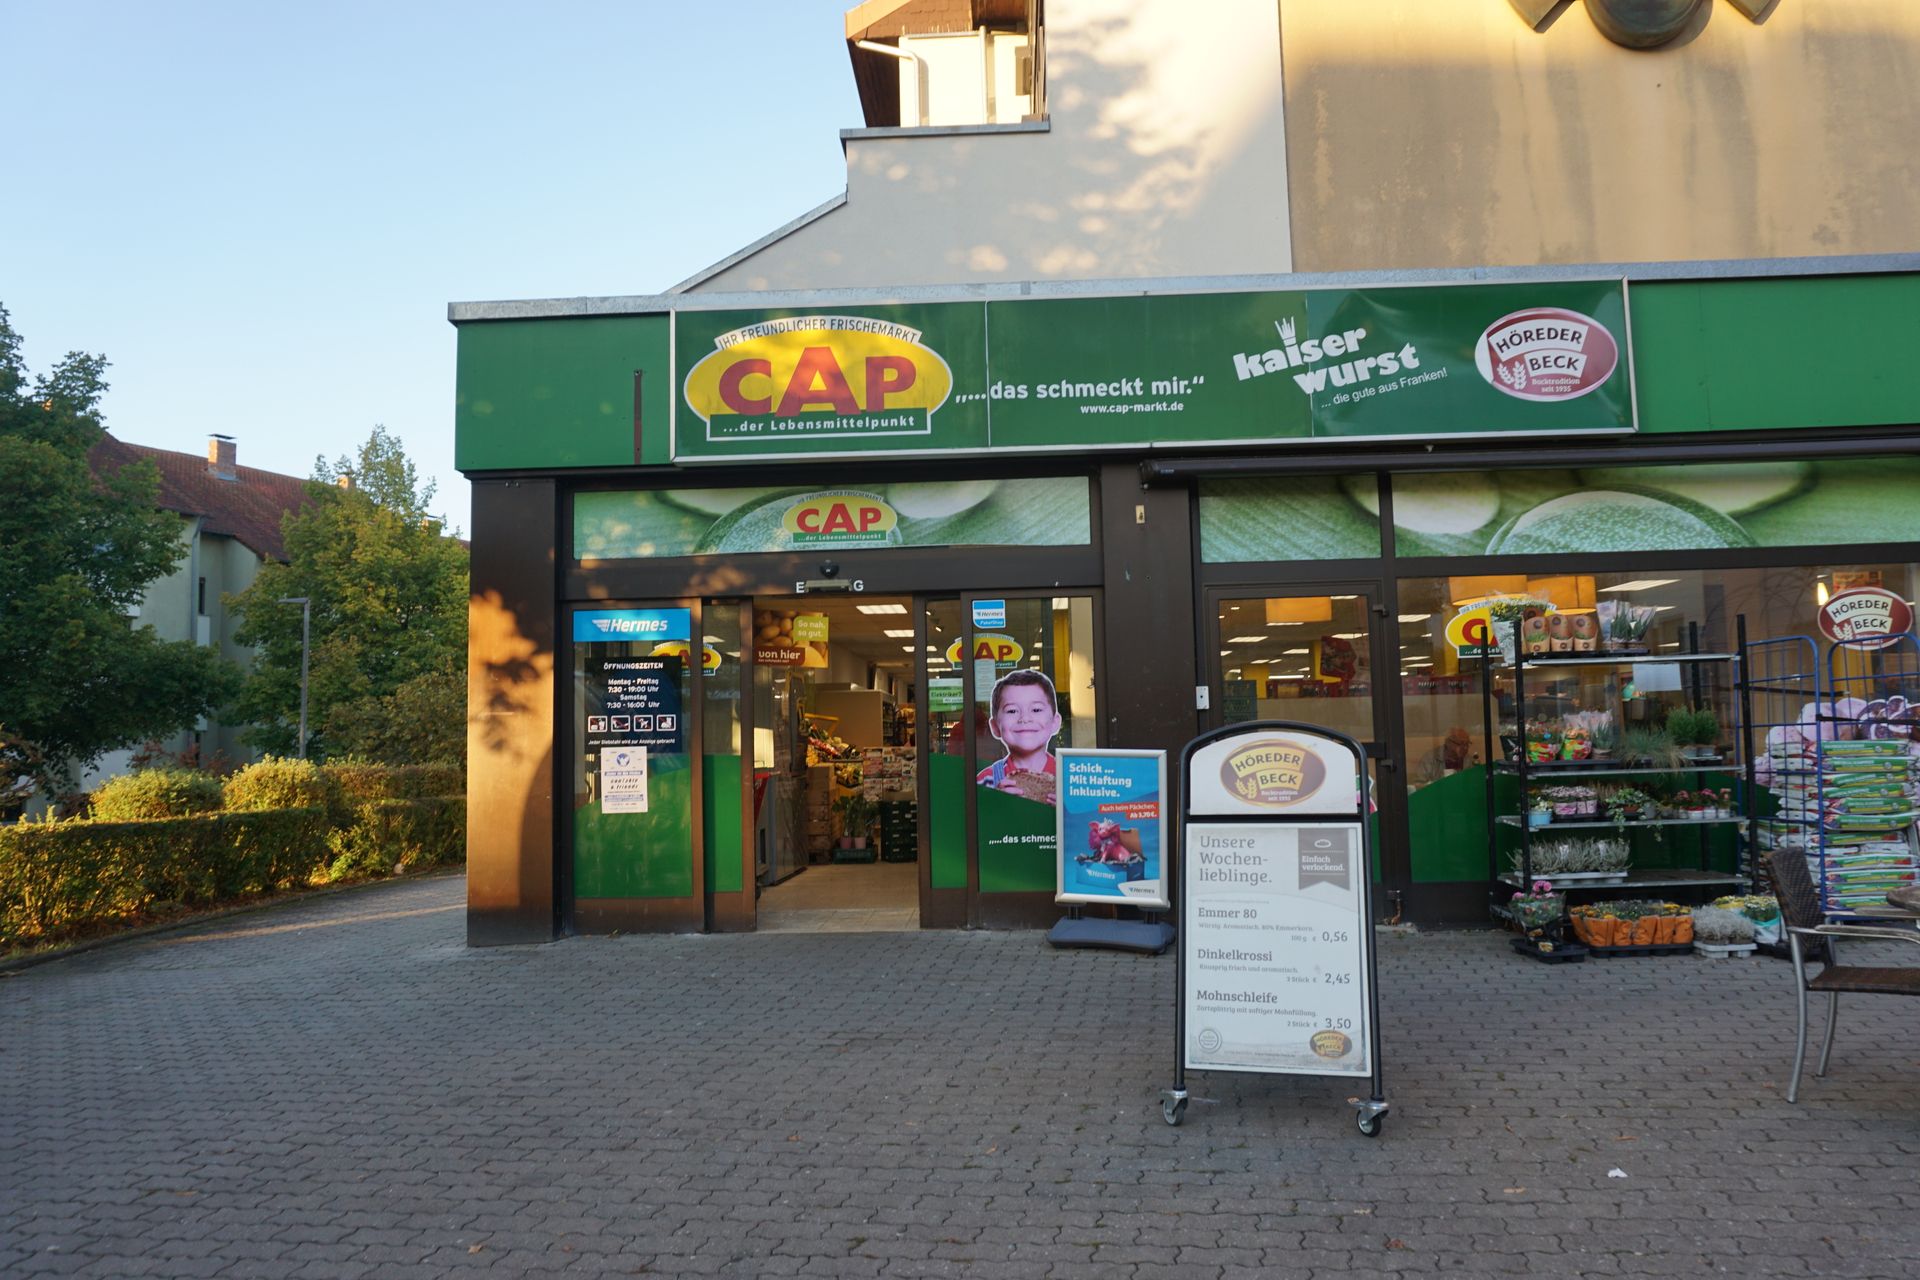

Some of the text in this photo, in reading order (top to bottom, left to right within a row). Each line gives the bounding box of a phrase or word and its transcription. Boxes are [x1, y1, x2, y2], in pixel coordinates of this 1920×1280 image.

[718, 318, 918, 351] IHR FREUNDLICHER FRISCHEMARKT
[1495, 327, 1583, 354] HÖREDER
[1232, 325, 1367, 382] kaiser
[1292, 342, 1421, 395] wurst
[1528, 355, 1581, 372] BECK
[718, 346, 917, 417] CAP
[1036, 377, 1144, 399] schmeckt
[1332, 393, 1350, 405] die
[1352, 387, 1376, 403] gute
[1378, 381, 1398, 395] aus
[1400, 367, 1448, 388] Franken!
[1080, 401, 1184, 415] www.cap-markt.de
[723, 415, 915, 433] ...der Lebensmittelpunkt
[796, 502, 882, 535] CAP
[818, 533, 882, 541] Lebensmittelpunkt
[1831, 599, 1889, 618] HÖREDER
[610, 618, 668, 633] Hermes
[1854, 618, 1888, 630] BECK
[780, 648, 801, 661] hier
[603, 661, 664, 670] ÖFFNUNGSZEITEN
[607, 678, 631, 686] Montag
[636, 678, 659, 686] Freitag
[1069, 763, 1102, 773] Schick
[1235, 752, 1301, 772] HÖREDER
[1069, 775, 1132, 788] Mit Haftung
[1260, 773, 1298, 785] BECK
[1069, 786, 1120, 798] inklusive.
[1021, 834, 1056, 844] schmec
[1199, 835, 1256, 849] Unsere
[1199, 852, 1269, 865] Wochen-
[1301, 855, 1331, 863] Einfach
[1301, 863, 1346, 872] verlockend.
[1199, 868, 1273, 886] lieblinge.
[1198, 907, 1257, 919] Emmer 80
[1322, 931, 1348, 944] 0,56
[1197, 949, 1273, 962] Dinkelkrossi
[1325, 973, 1350, 985] 2,45
[1197, 990, 1278, 1004] Mohnschleife
[1325, 1018, 1351, 1031] 3,50
